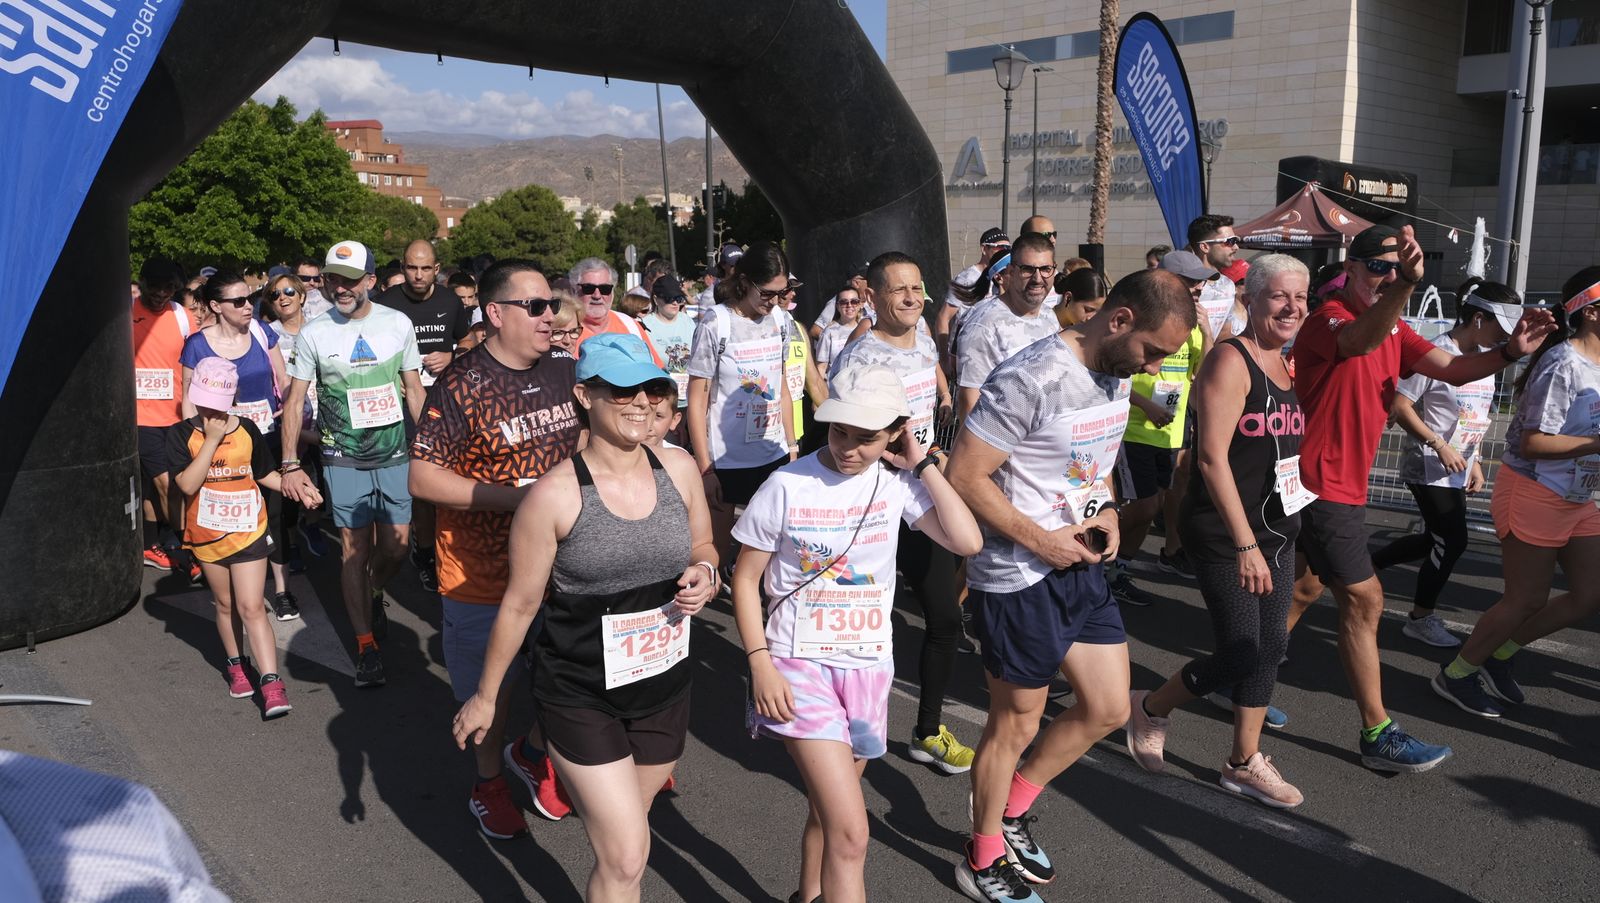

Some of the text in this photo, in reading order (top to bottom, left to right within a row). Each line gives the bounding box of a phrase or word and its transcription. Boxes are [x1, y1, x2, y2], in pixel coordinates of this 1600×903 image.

[87, 0, 163, 122] centrohogar
[414, 324, 446, 333] ENTINO
[136, 378, 170, 388] 1289
[357, 395, 397, 414] 1292
[207, 468, 232, 477] ABO
[208, 503, 252, 518] 1301
[799, 507, 845, 519] CARRERA
[813, 589, 847, 599] CARRERA
[848, 590, 862, 599] SIN
[620, 615, 655, 628] CARRERA
[810, 608, 882, 631] 1300
[620, 621, 684, 658] 1293
[834, 633, 861, 641] JIMENA
